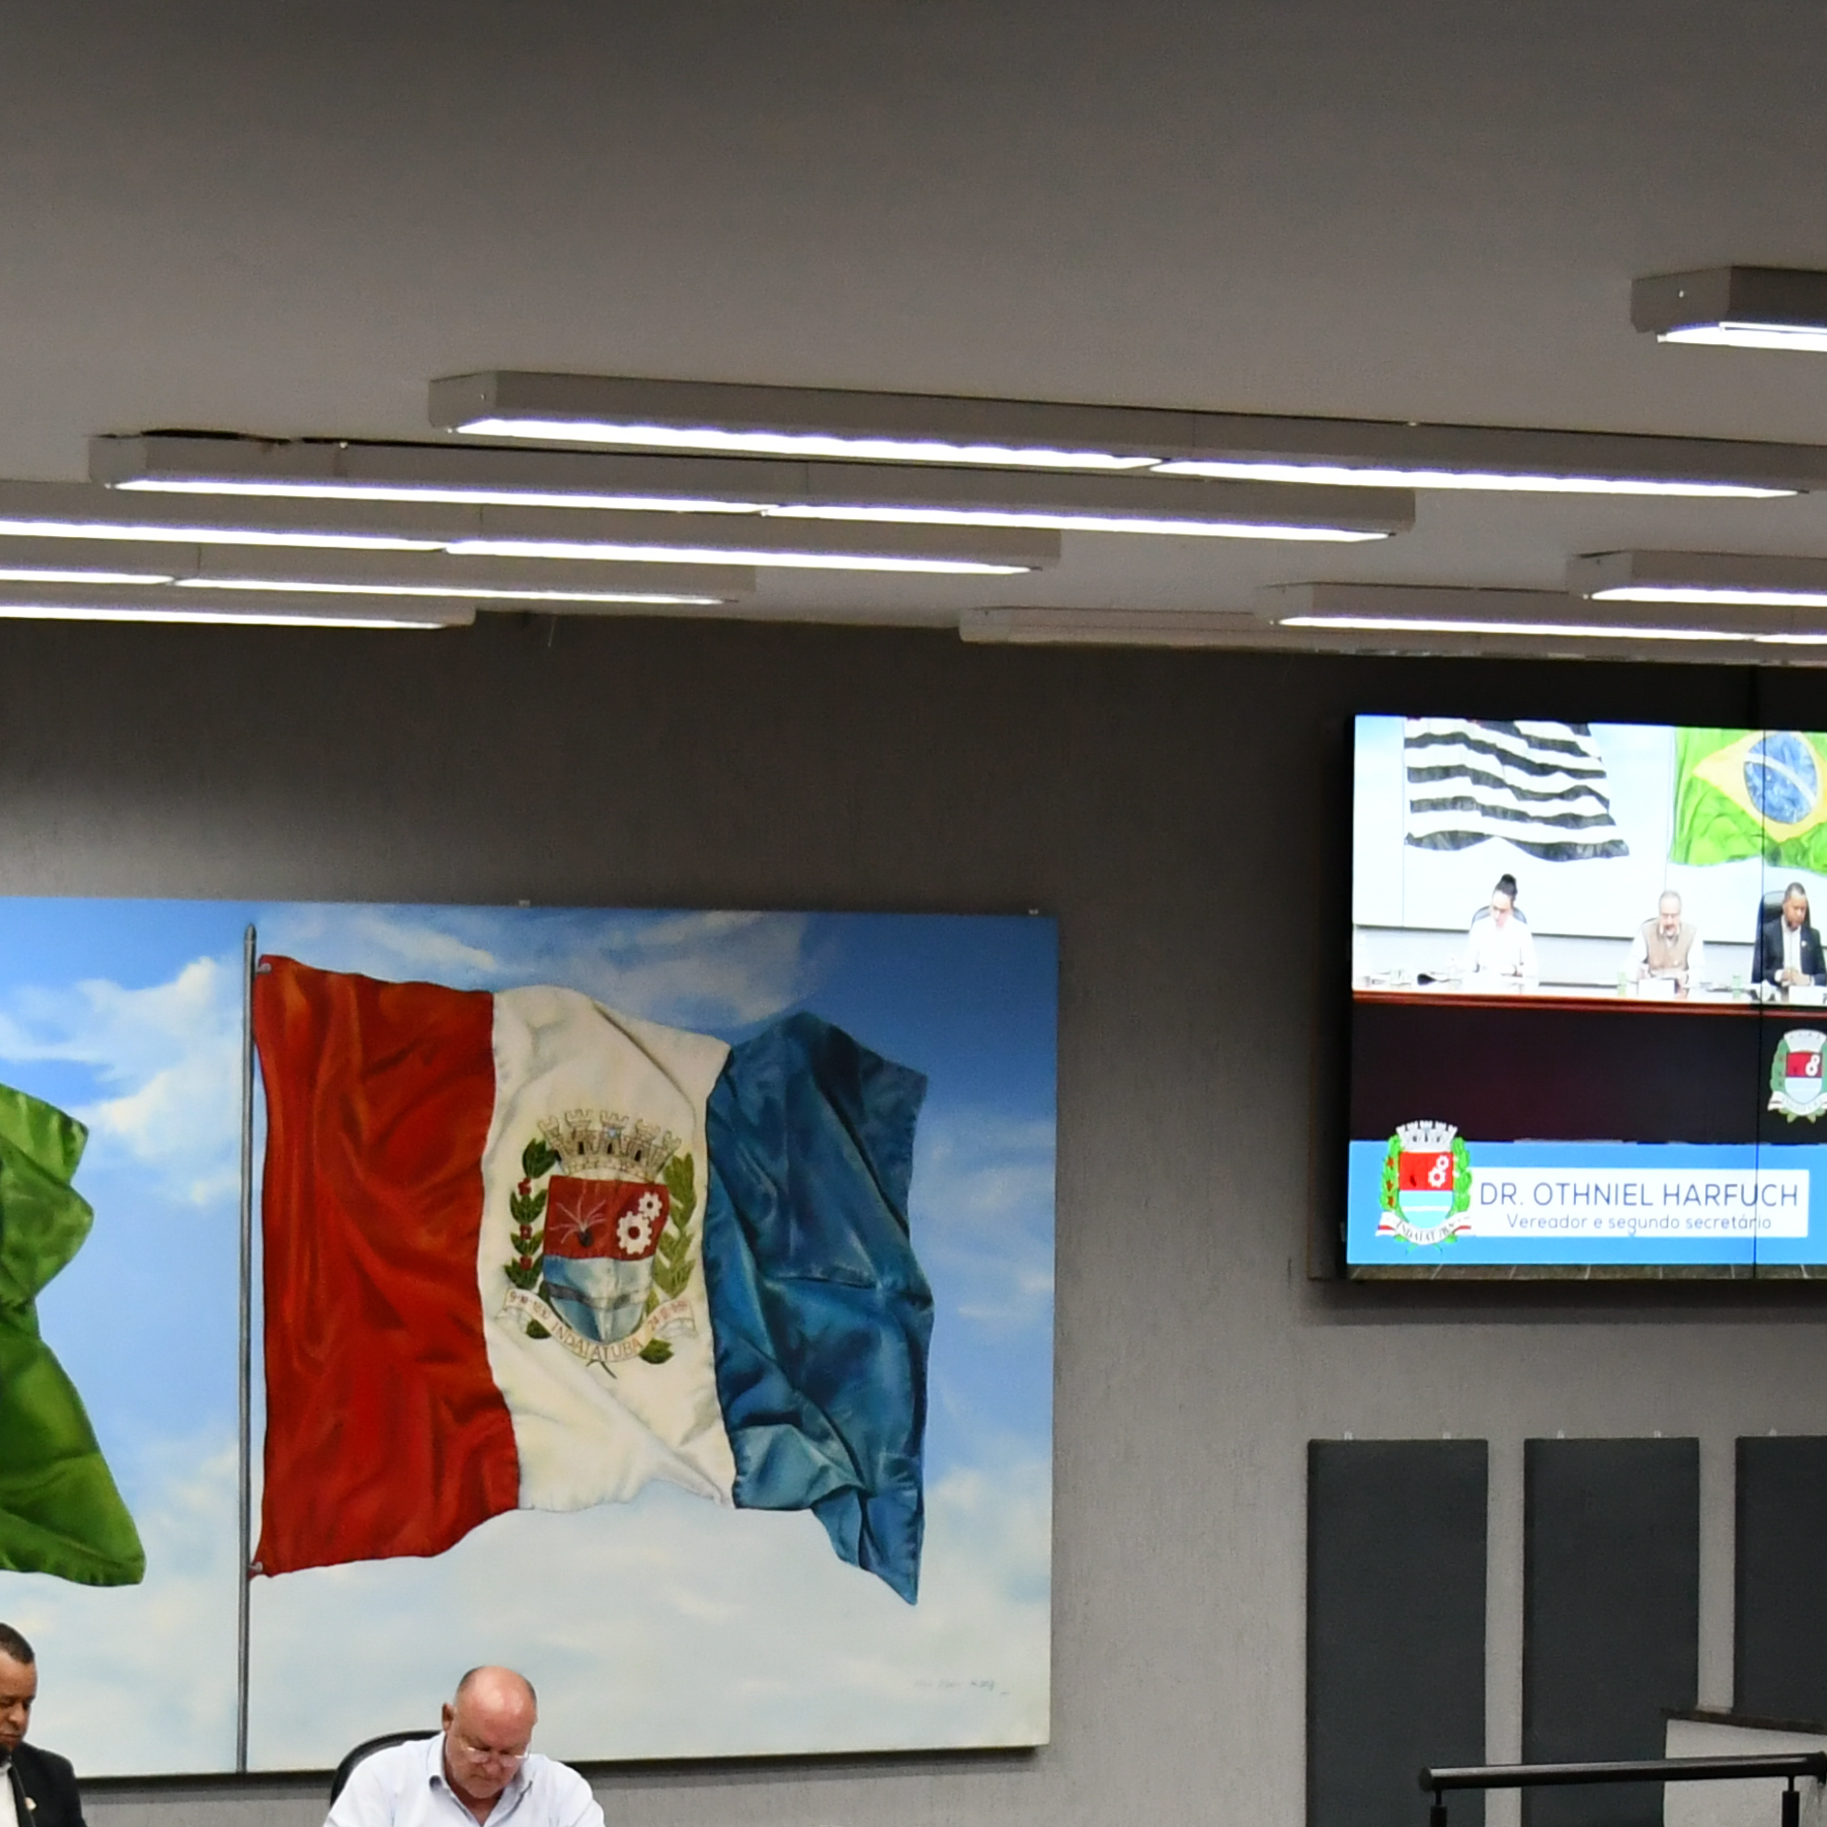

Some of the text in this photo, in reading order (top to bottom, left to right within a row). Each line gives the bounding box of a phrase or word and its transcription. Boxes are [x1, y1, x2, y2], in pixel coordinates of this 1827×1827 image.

[1480, 1182, 1797, 1207] DR. OTHNIEL HARFUCH
[1507, 1213, 1772, 1236] Vereador e segundo secretário
[550, 1321, 644, 1360] INDAIATUBA
